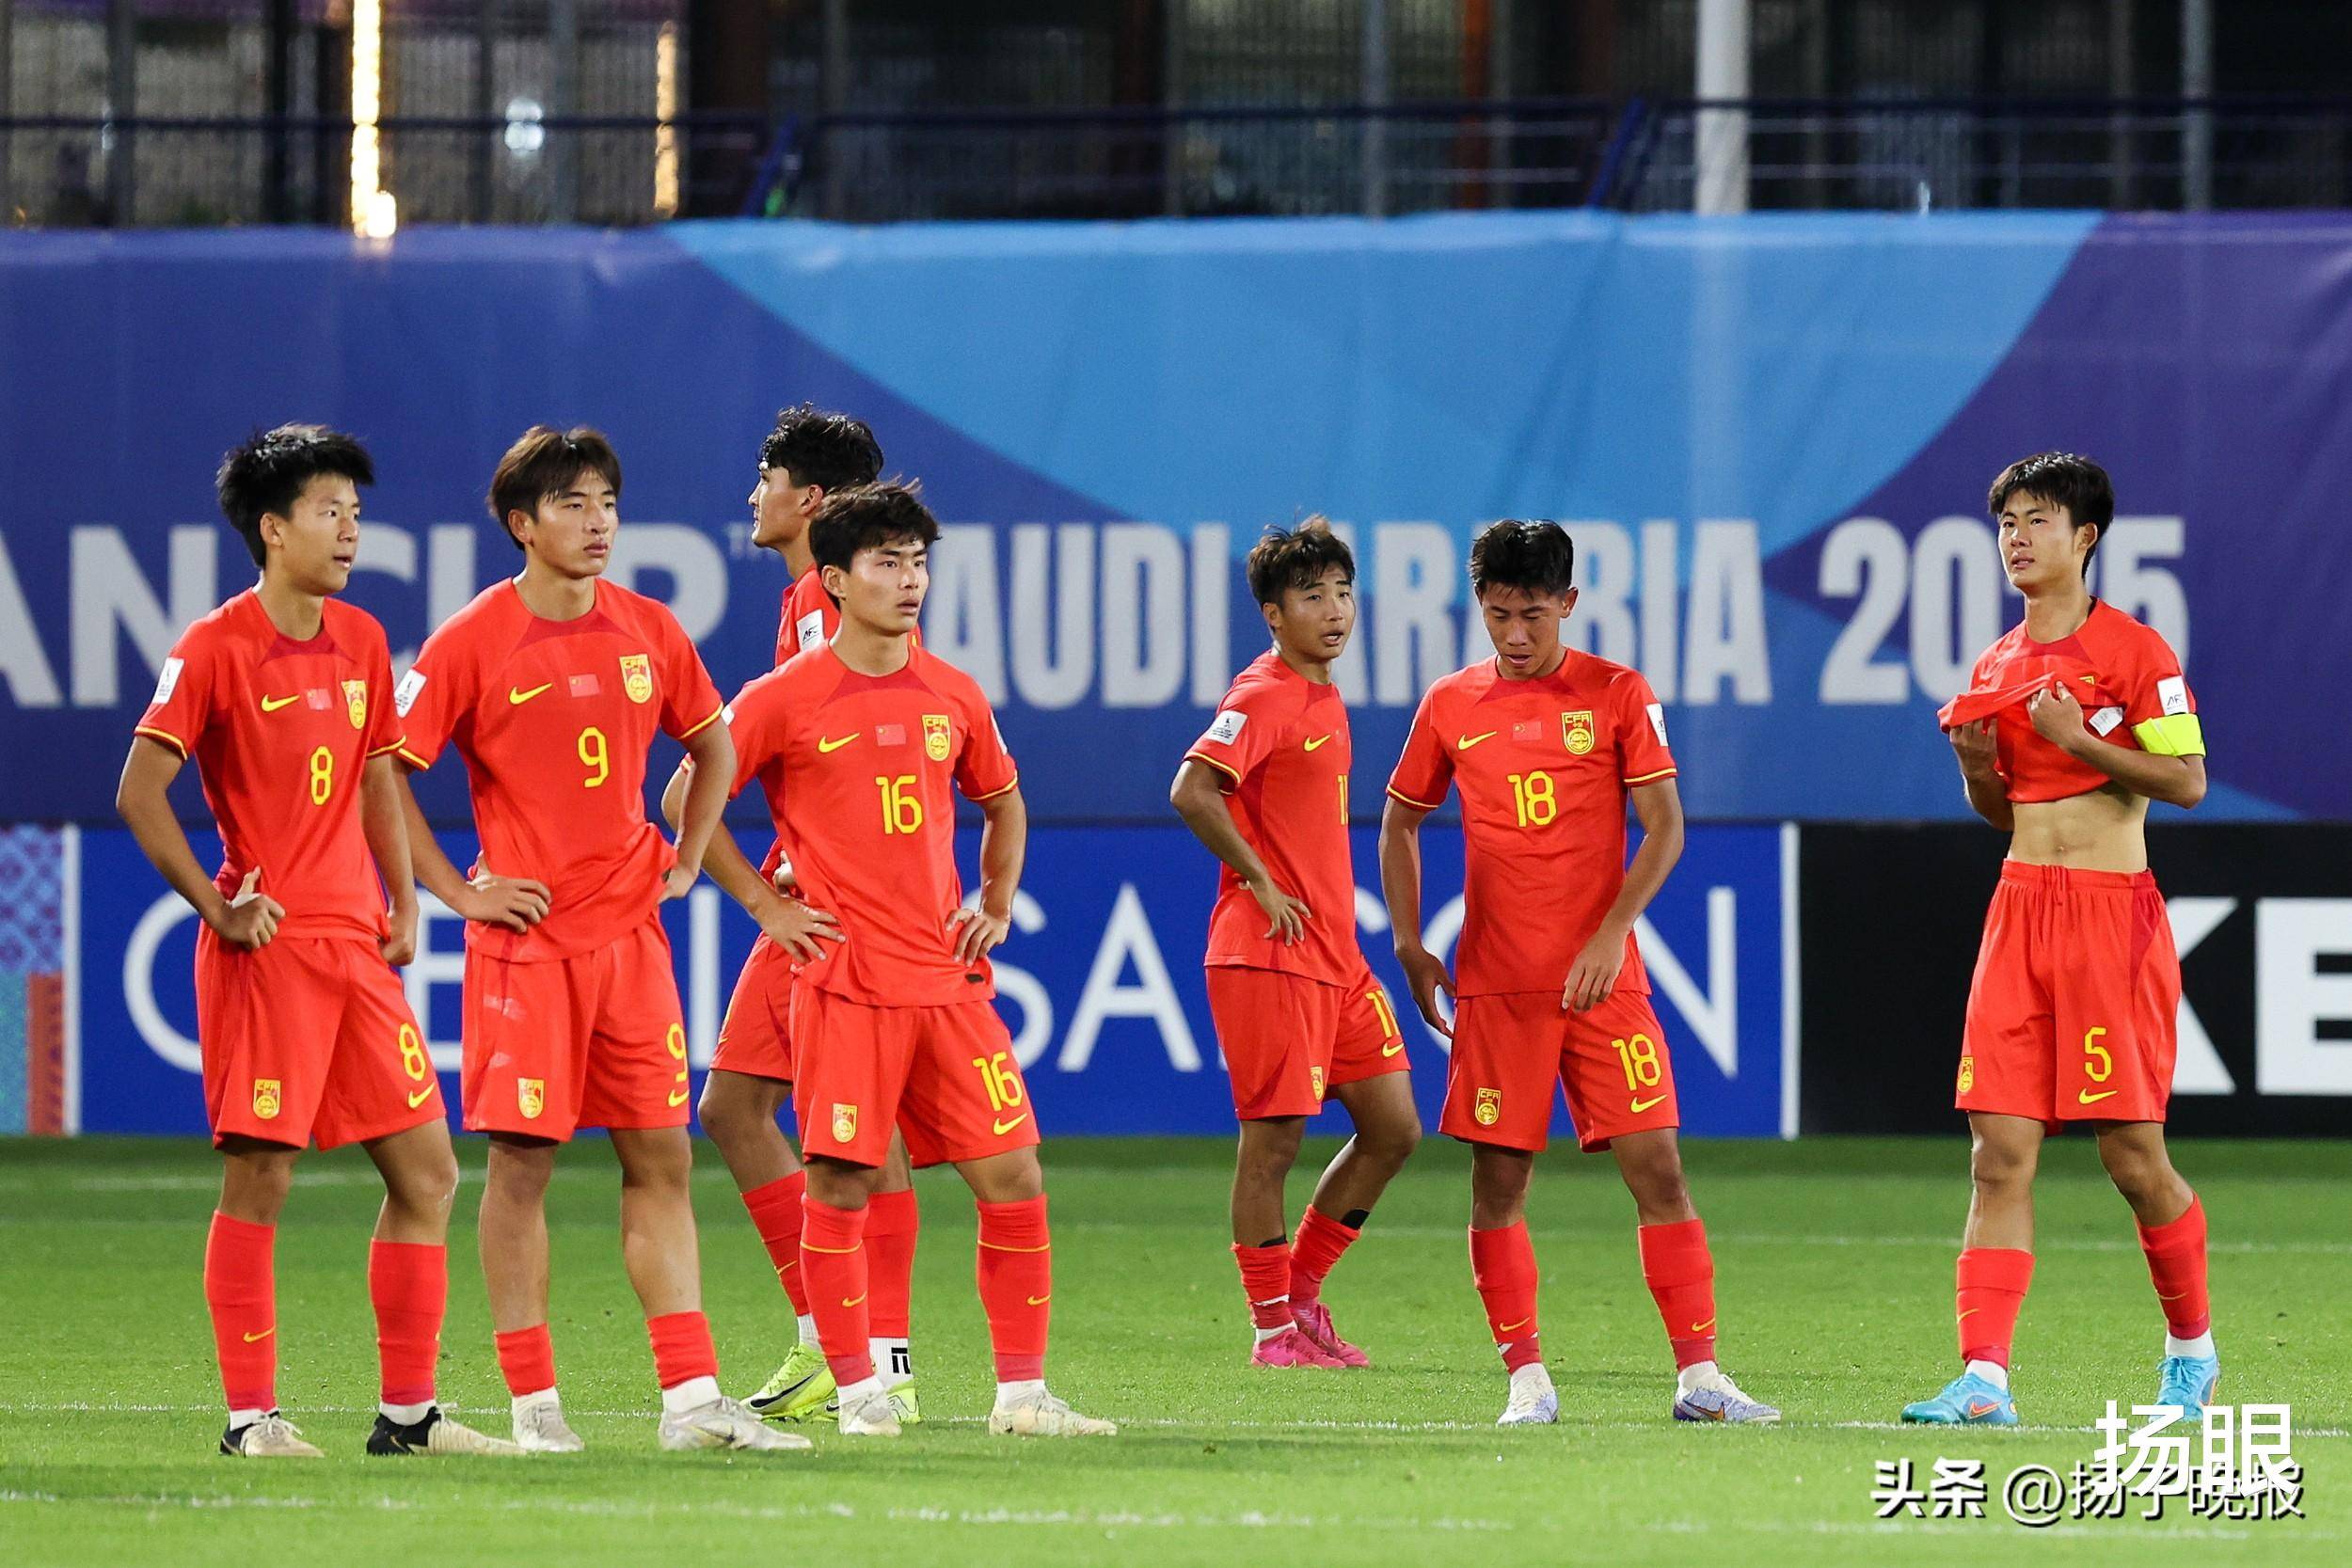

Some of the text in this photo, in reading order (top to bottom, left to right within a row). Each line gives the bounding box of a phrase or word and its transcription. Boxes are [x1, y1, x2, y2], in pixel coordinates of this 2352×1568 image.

[922, 522, 1231, 708] AUDI
[1818, 515, 2190, 705] 205
[1565, 713, 1590, 724] CFA
[310, 745, 333, 805] 8
[577, 726, 610, 787] 9
[875, 774, 924, 835] 16
[1507, 770, 1557, 828] 18
[399, 1022, 426, 1082] 8
[666, 1022, 689, 1083] 9
[972, 1051, 1023, 1112] 16
[1611, 1033, 1661, 1091] 18
[2084, 1026, 2112, 1082] 5
